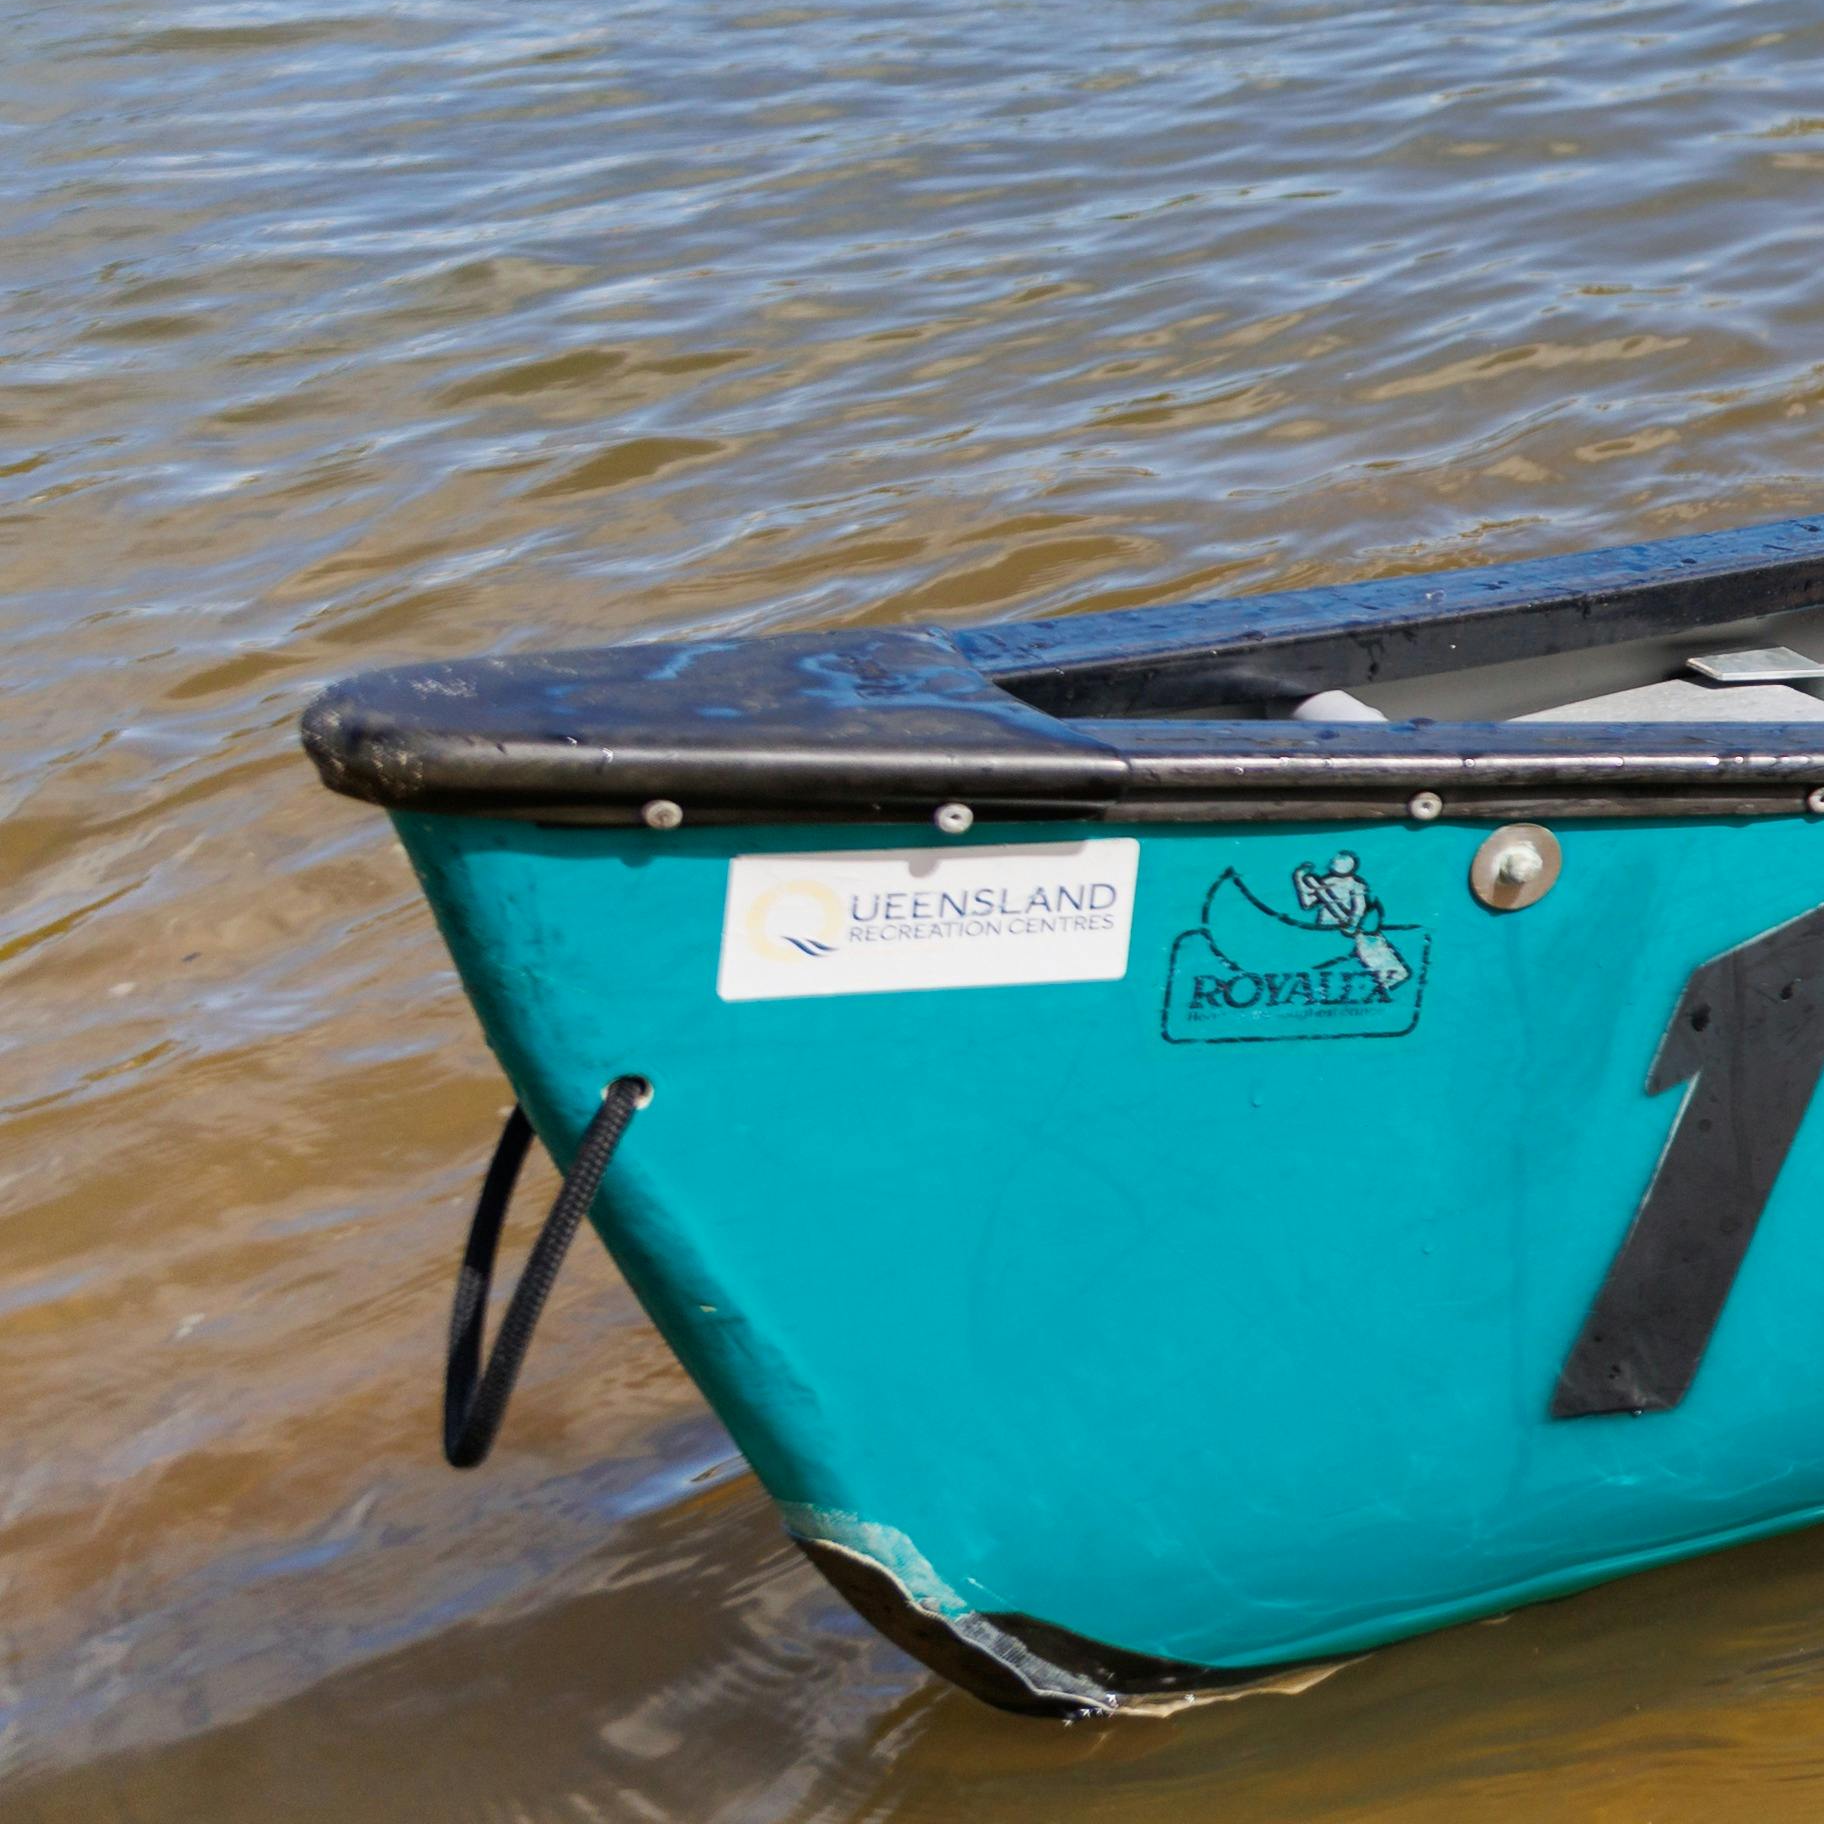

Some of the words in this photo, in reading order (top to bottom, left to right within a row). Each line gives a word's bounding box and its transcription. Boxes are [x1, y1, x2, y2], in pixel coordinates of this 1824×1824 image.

[850, 918, 1002, 943] RECREATION
[1008, 913, 1115, 935] CENTRES
[1189, 970, 1393, 1009] ROYALEX
